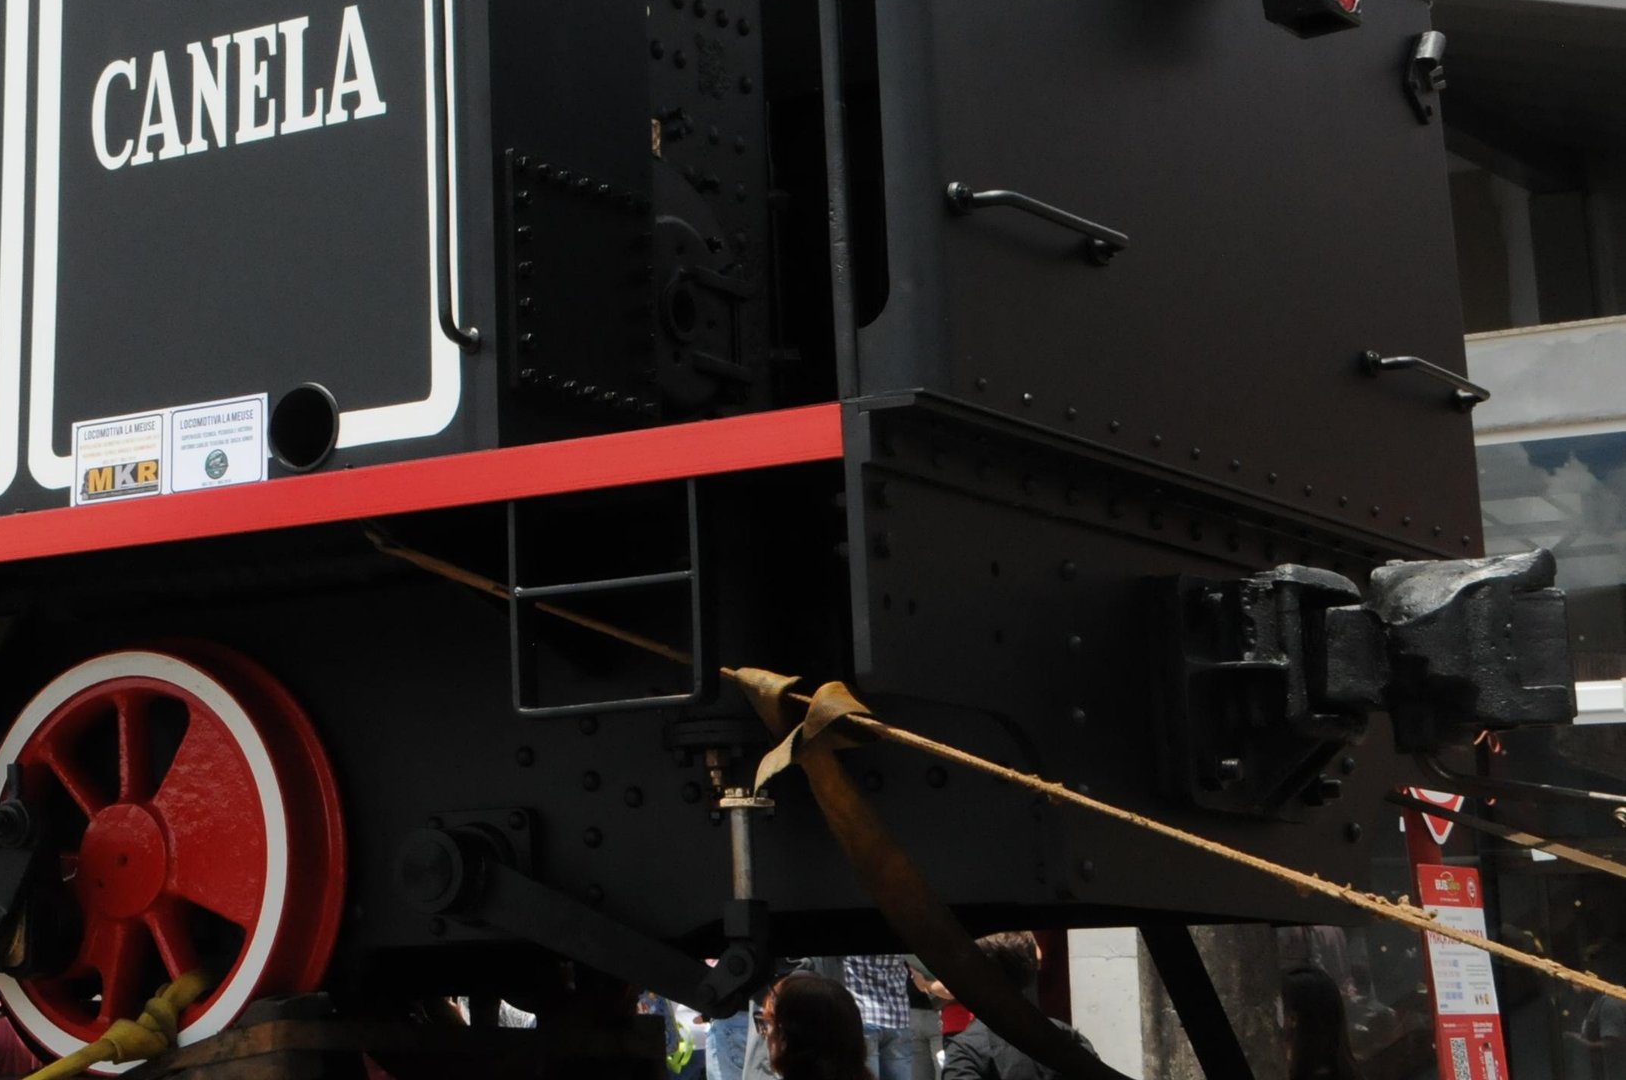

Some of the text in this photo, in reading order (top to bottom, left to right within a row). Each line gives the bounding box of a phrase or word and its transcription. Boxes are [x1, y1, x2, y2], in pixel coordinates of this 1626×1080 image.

[91, 5, 387, 171] CANELA
[83, 421, 156, 441] LOCOMOTIVA LA MEUSE
[179, 409, 254, 430] LOCOMOTIVA LA MEUSE
[88, 461, 158, 494] MKR
